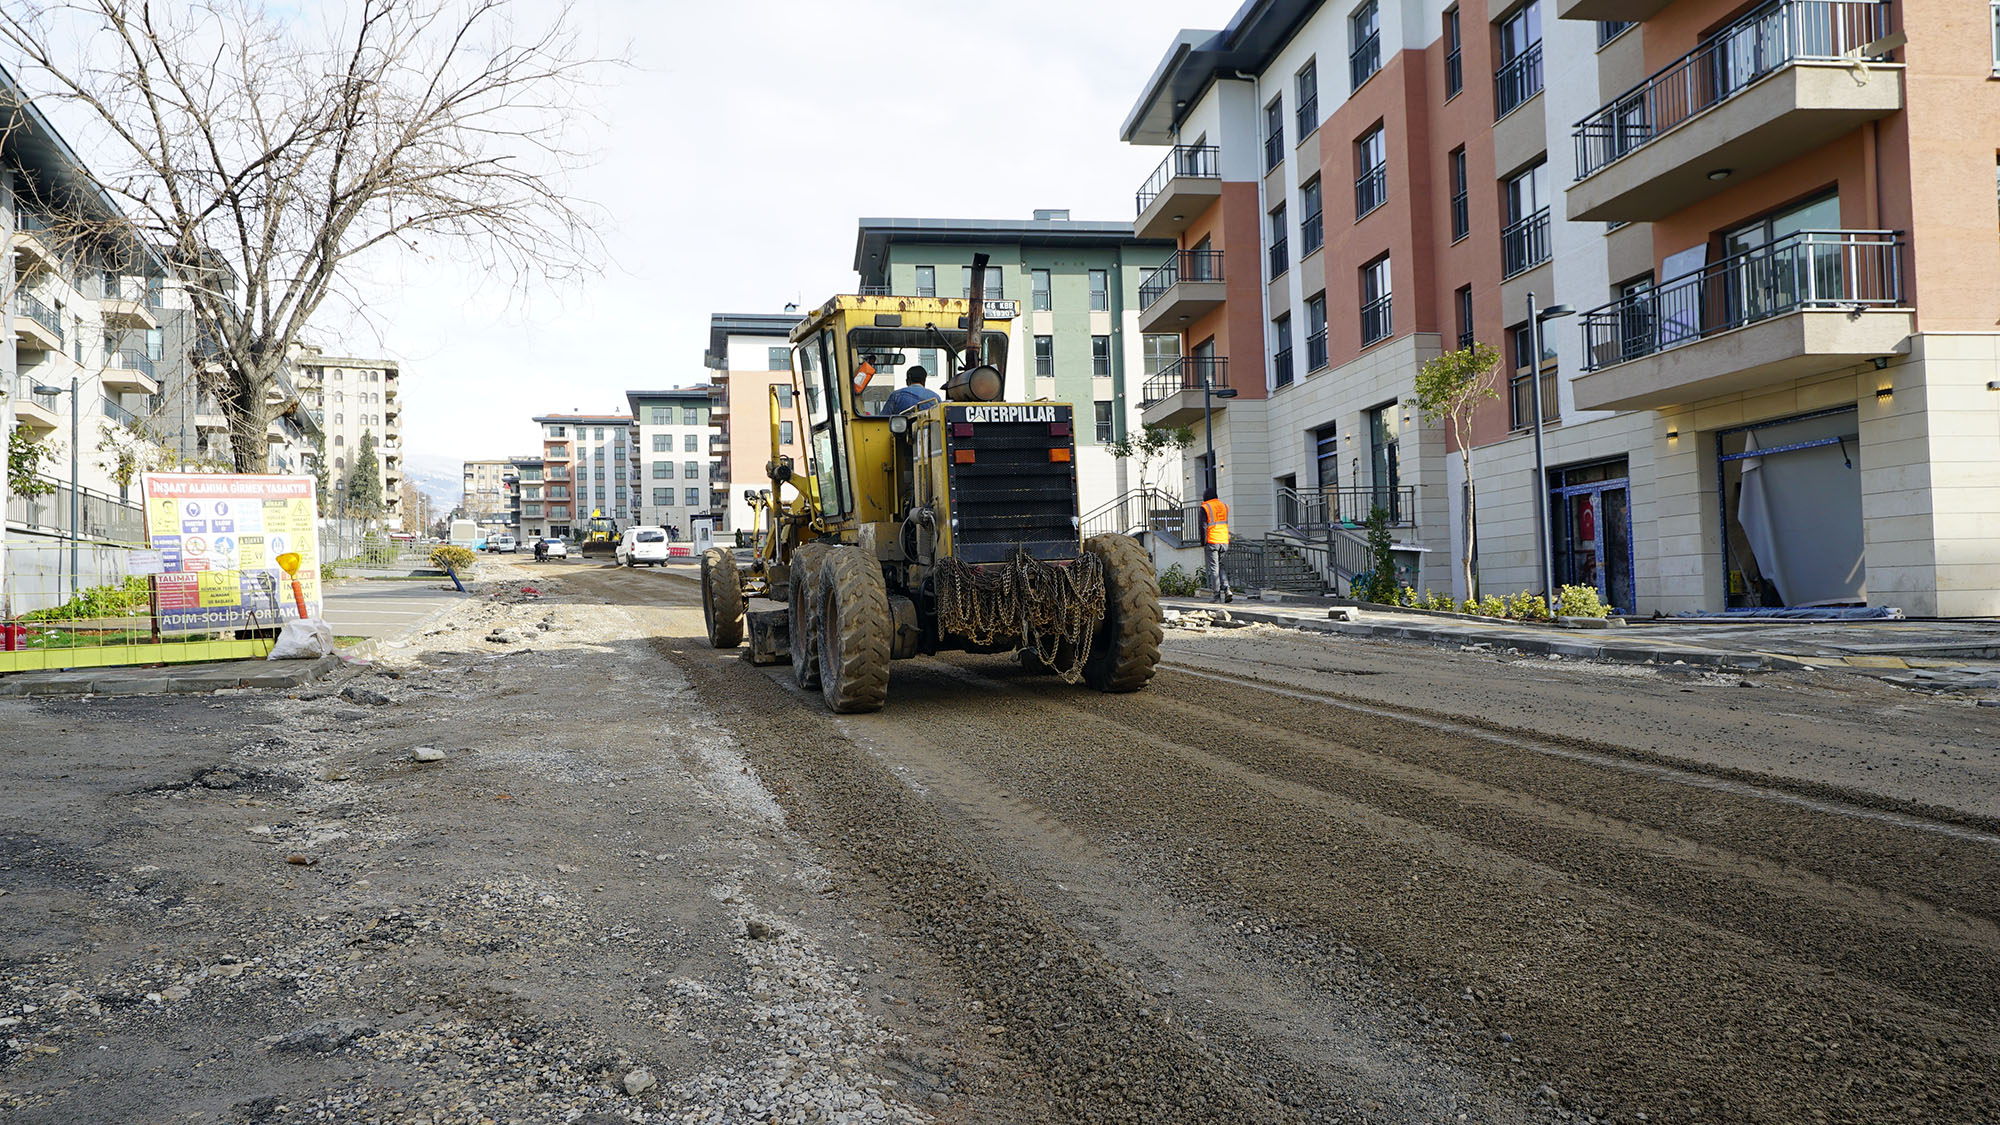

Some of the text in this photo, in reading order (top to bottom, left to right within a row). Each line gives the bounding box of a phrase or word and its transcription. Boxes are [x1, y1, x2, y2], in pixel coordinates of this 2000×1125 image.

[965, 406, 1056, 423] CATERPILLAR
[153, 480, 307, 495] İNŞAAT ALANINA GİRMEK YASAKTIR
[283, 582, 313, 590] İNAAT
